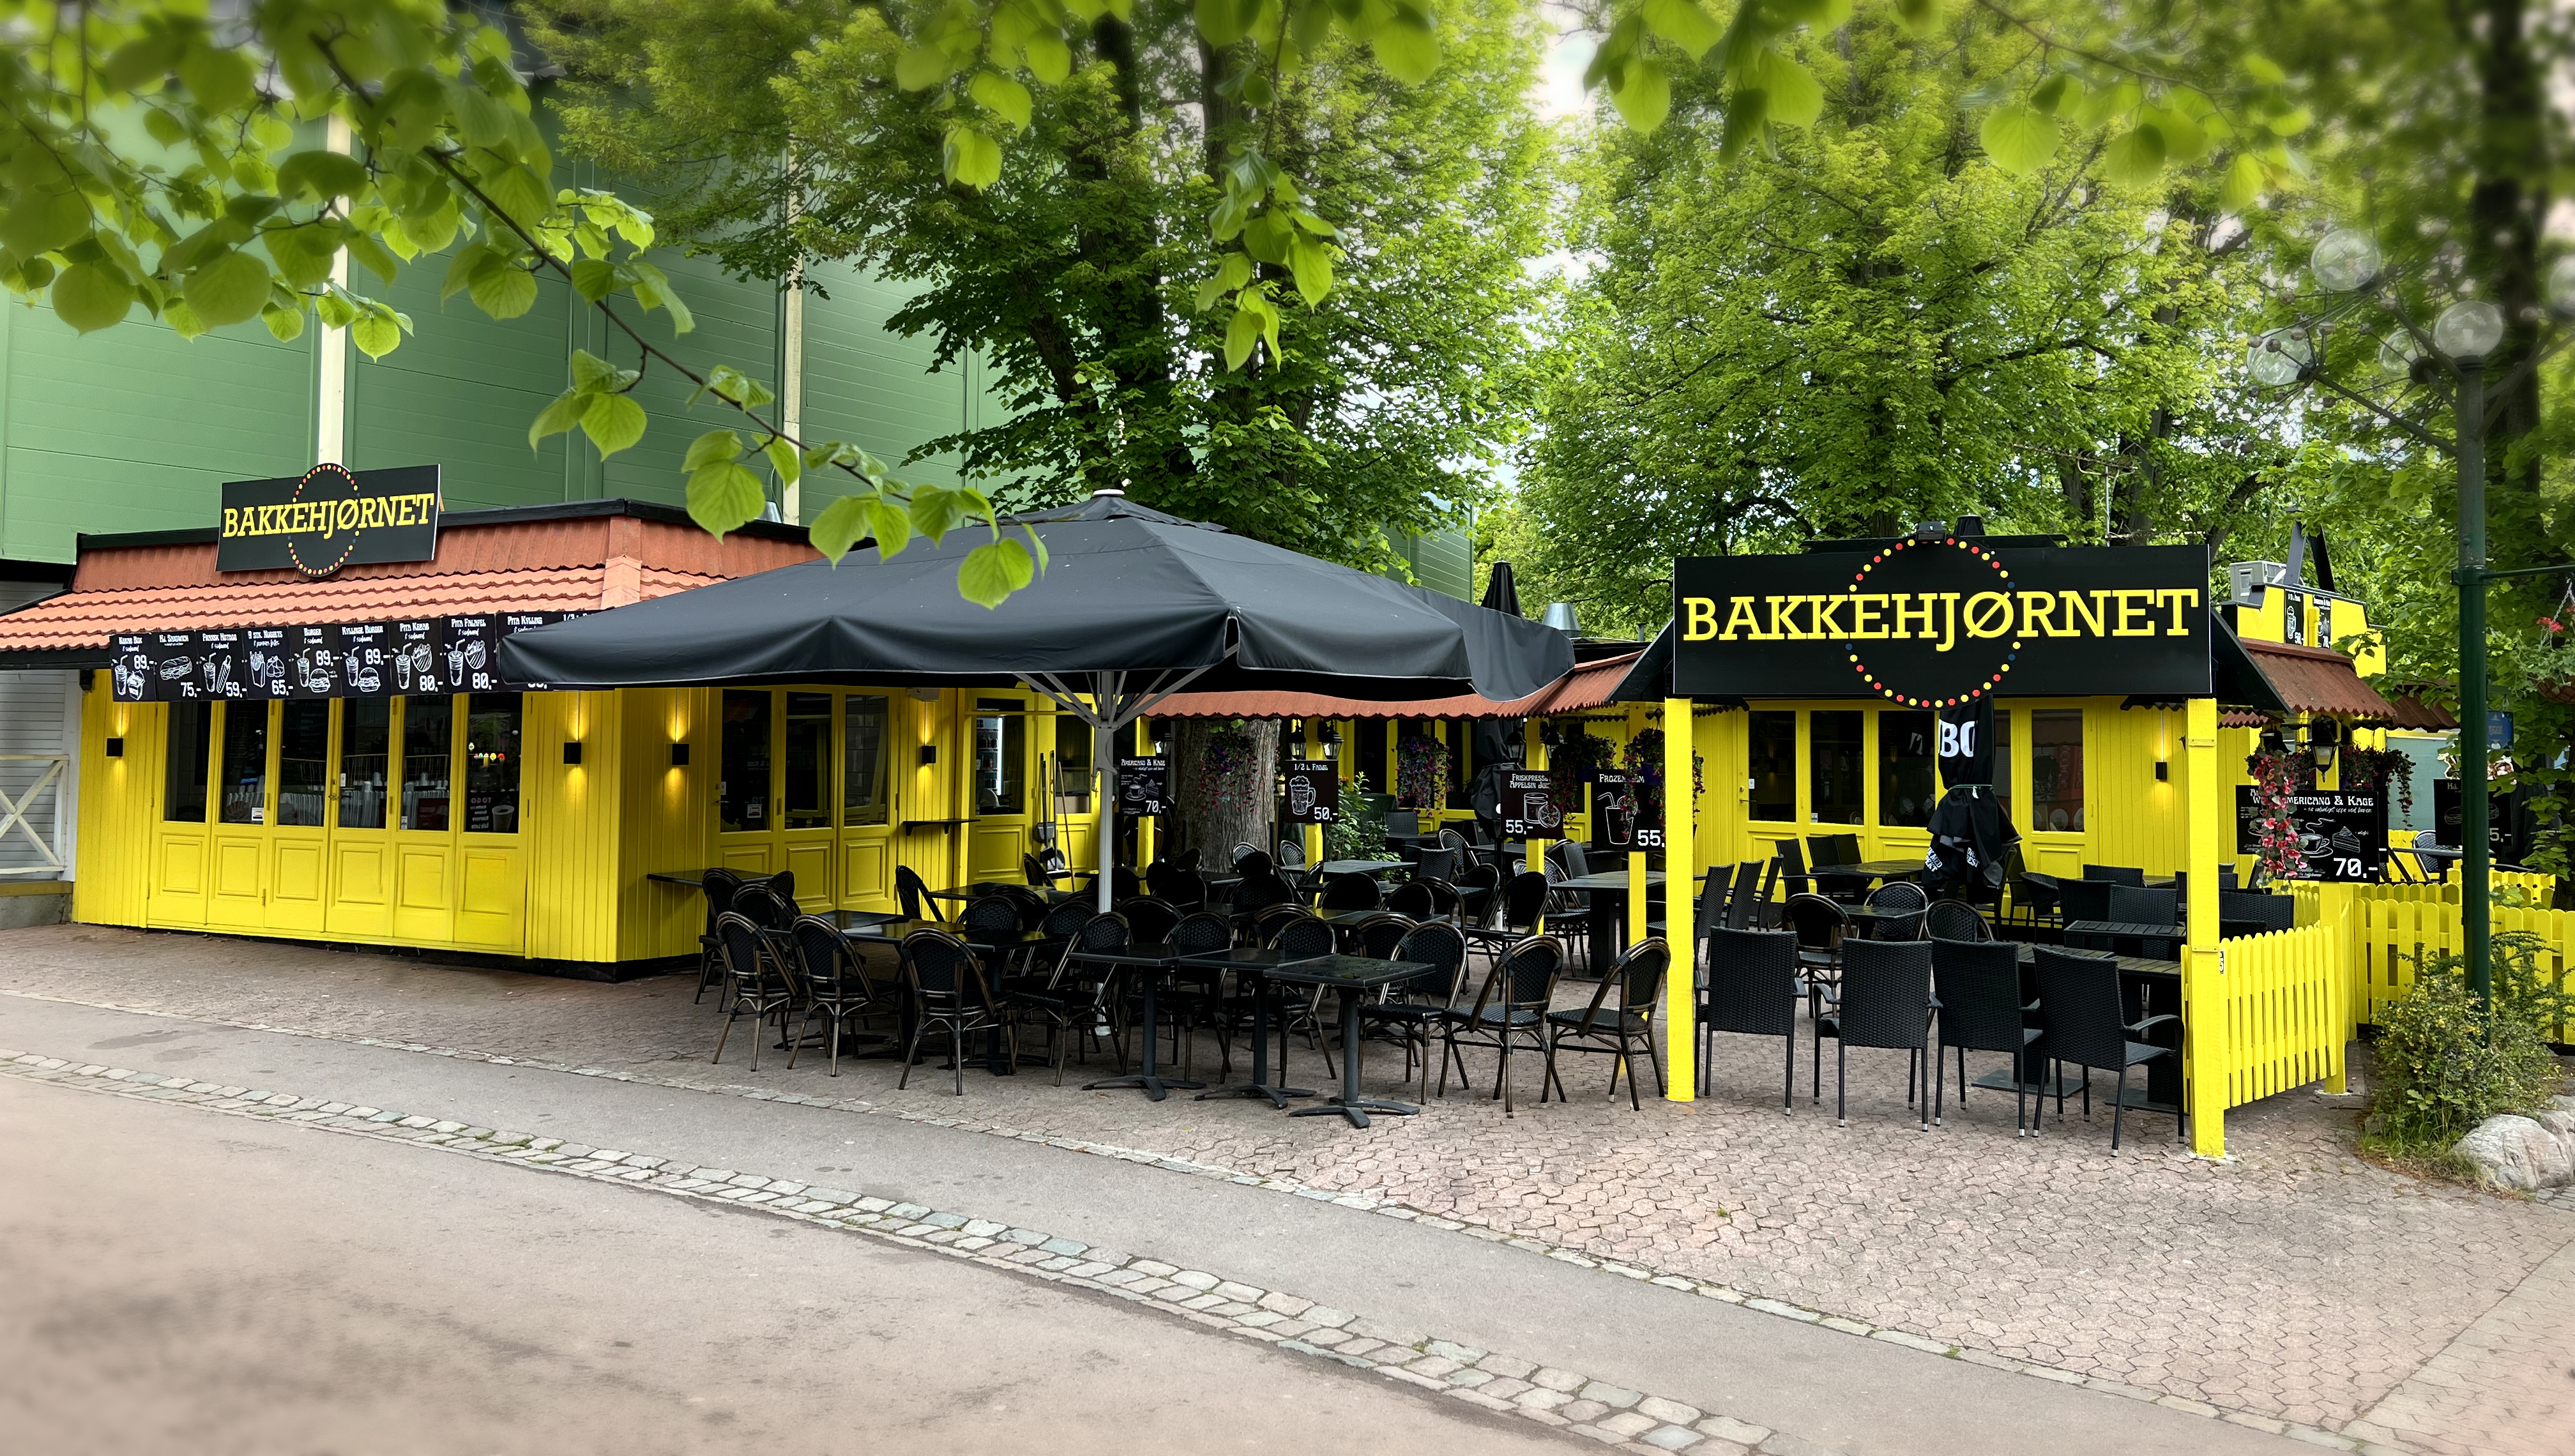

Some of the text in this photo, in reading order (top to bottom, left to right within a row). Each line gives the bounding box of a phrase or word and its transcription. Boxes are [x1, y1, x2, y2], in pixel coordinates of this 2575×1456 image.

[223, 493, 434, 539] BAKKEHJØRNET
[1683, 588, 2199, 653] BAKKEHJØRNET
[2286, 796, 2374, 806] MERICANO & KAGE
